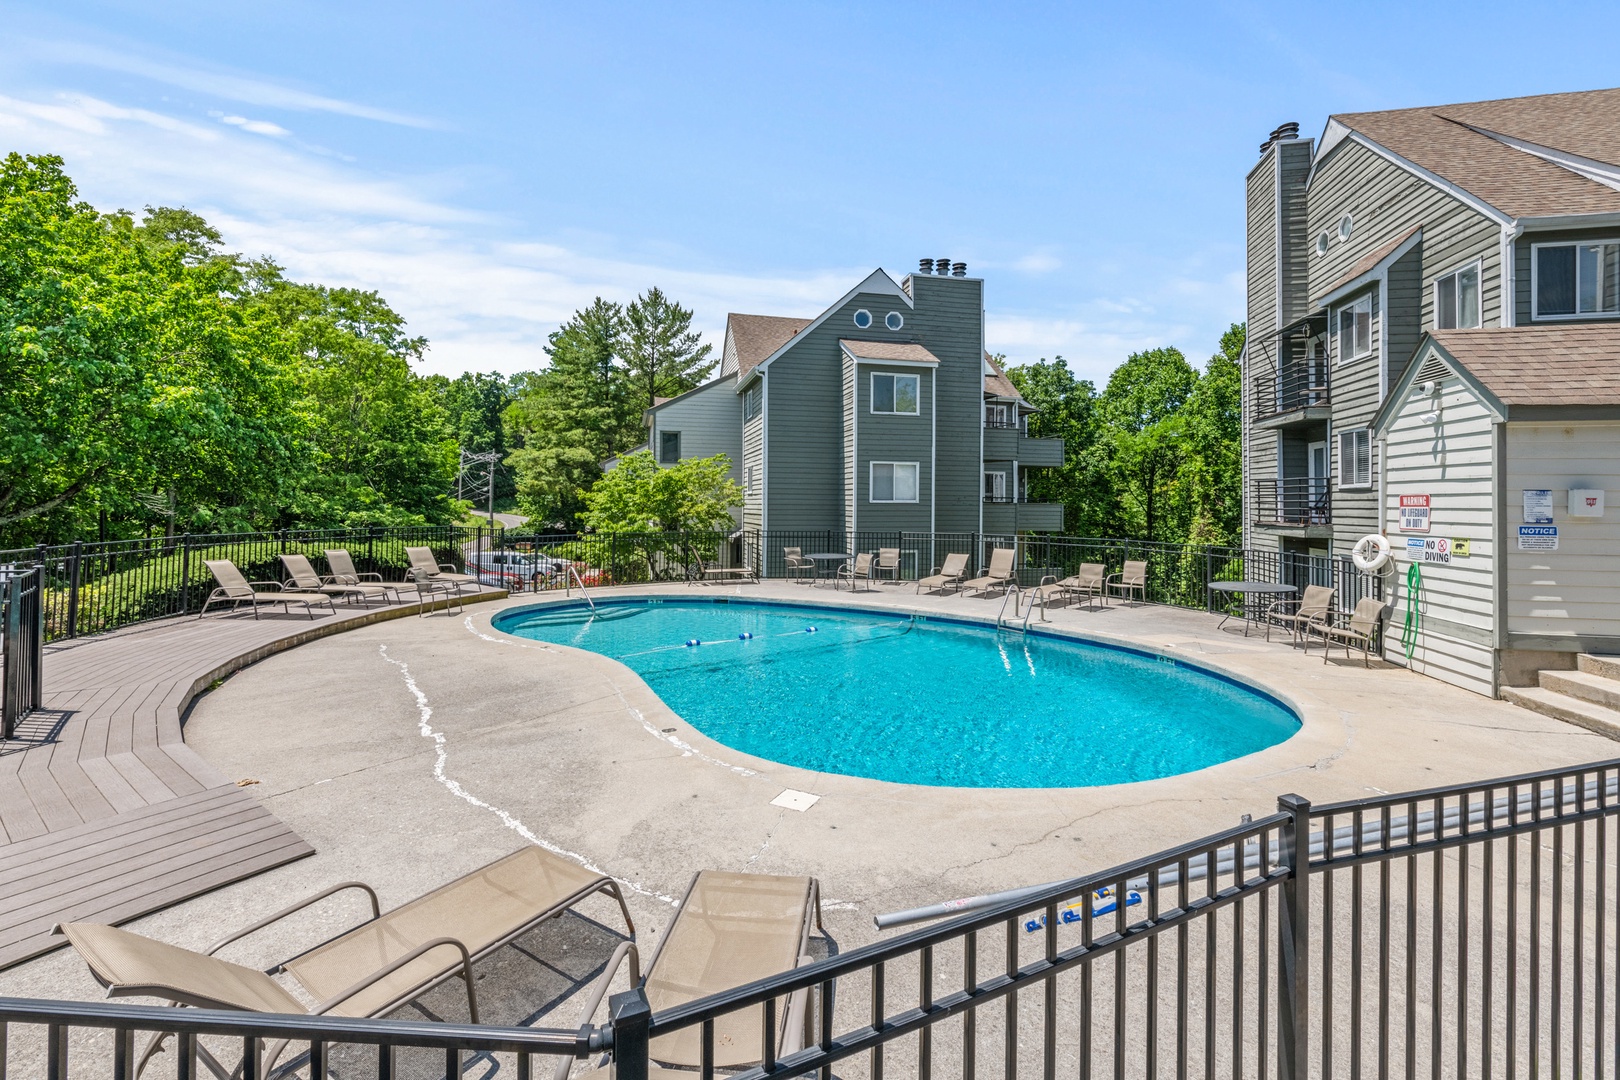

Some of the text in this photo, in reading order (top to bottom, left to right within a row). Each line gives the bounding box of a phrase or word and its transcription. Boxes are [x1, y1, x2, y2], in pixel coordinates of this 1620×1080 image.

[1402, 496, 1426, 506] WARNING
[1401, 508, 1428, 517] NO LIFEGUARD
[1405, 518, 1423, 528] ON DUTY
[1425, 540, 1435, 549] NO
[1425, 552, 1449, 562] DIVING
